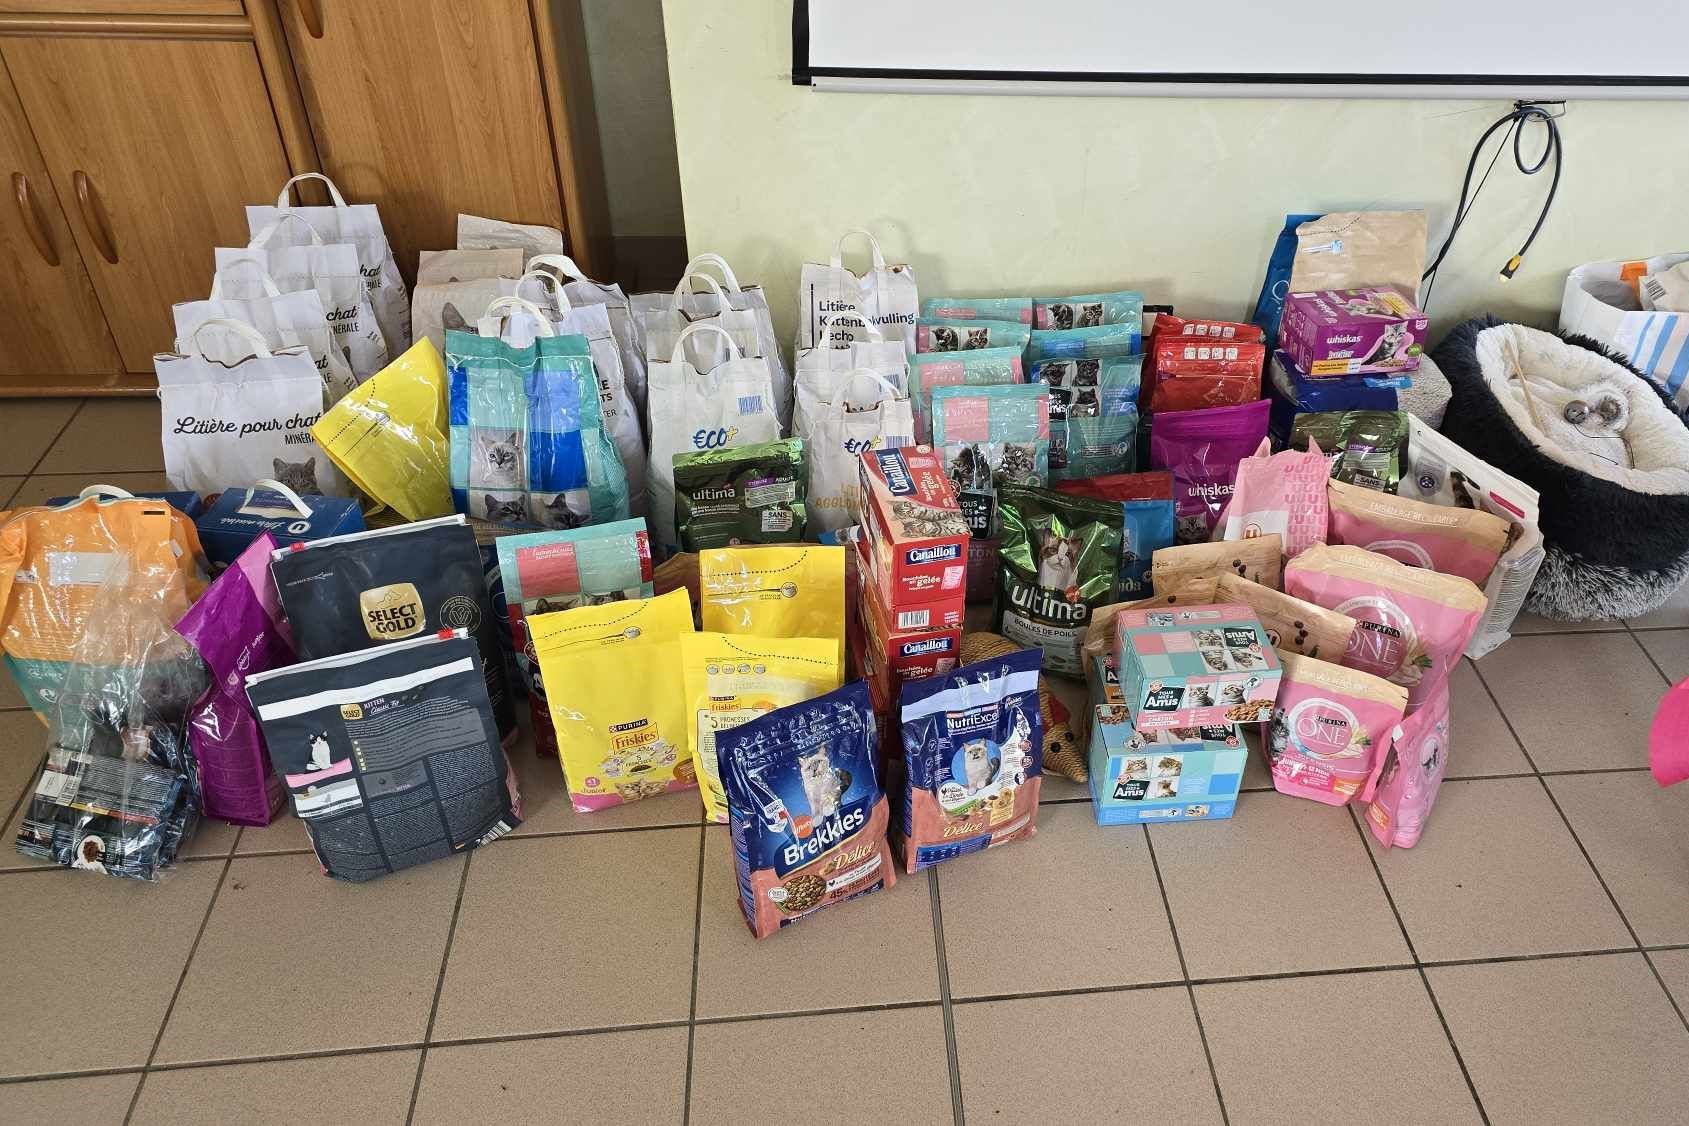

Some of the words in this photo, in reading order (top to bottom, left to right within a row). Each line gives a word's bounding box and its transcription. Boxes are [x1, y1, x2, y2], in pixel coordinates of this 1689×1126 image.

[326, 305, 358, 321] chat
[819, 300, 856, 312] Litière
[1327, 334, 1363, 344] whiskas
[174, 416, 238, 435] Litière
[239, 420, 282, 438] pour
[692, 487, 736, 501] ultima
[1188, 482, 1236, 498] whiskas
[768, 511, 788, 519] SANS
[909, 545, 956, 562] Canaillou
[1011, 585, 1087, 620] ultima
[368, 602, 417, 623] SELECT
[376, 617, 417, 634] GOLD
[1014, 617, 1041, 633] BOULES
[1042, 628, 1054, 636] DE
[904, 639, 948, 655] Canaillou
[617, 719, 648, 731] PURINA
[1297, 717, 1348, 745] ONE
[615, 732, 656, 750] Friskies
[783, 807, 865, 867] Brekkies
